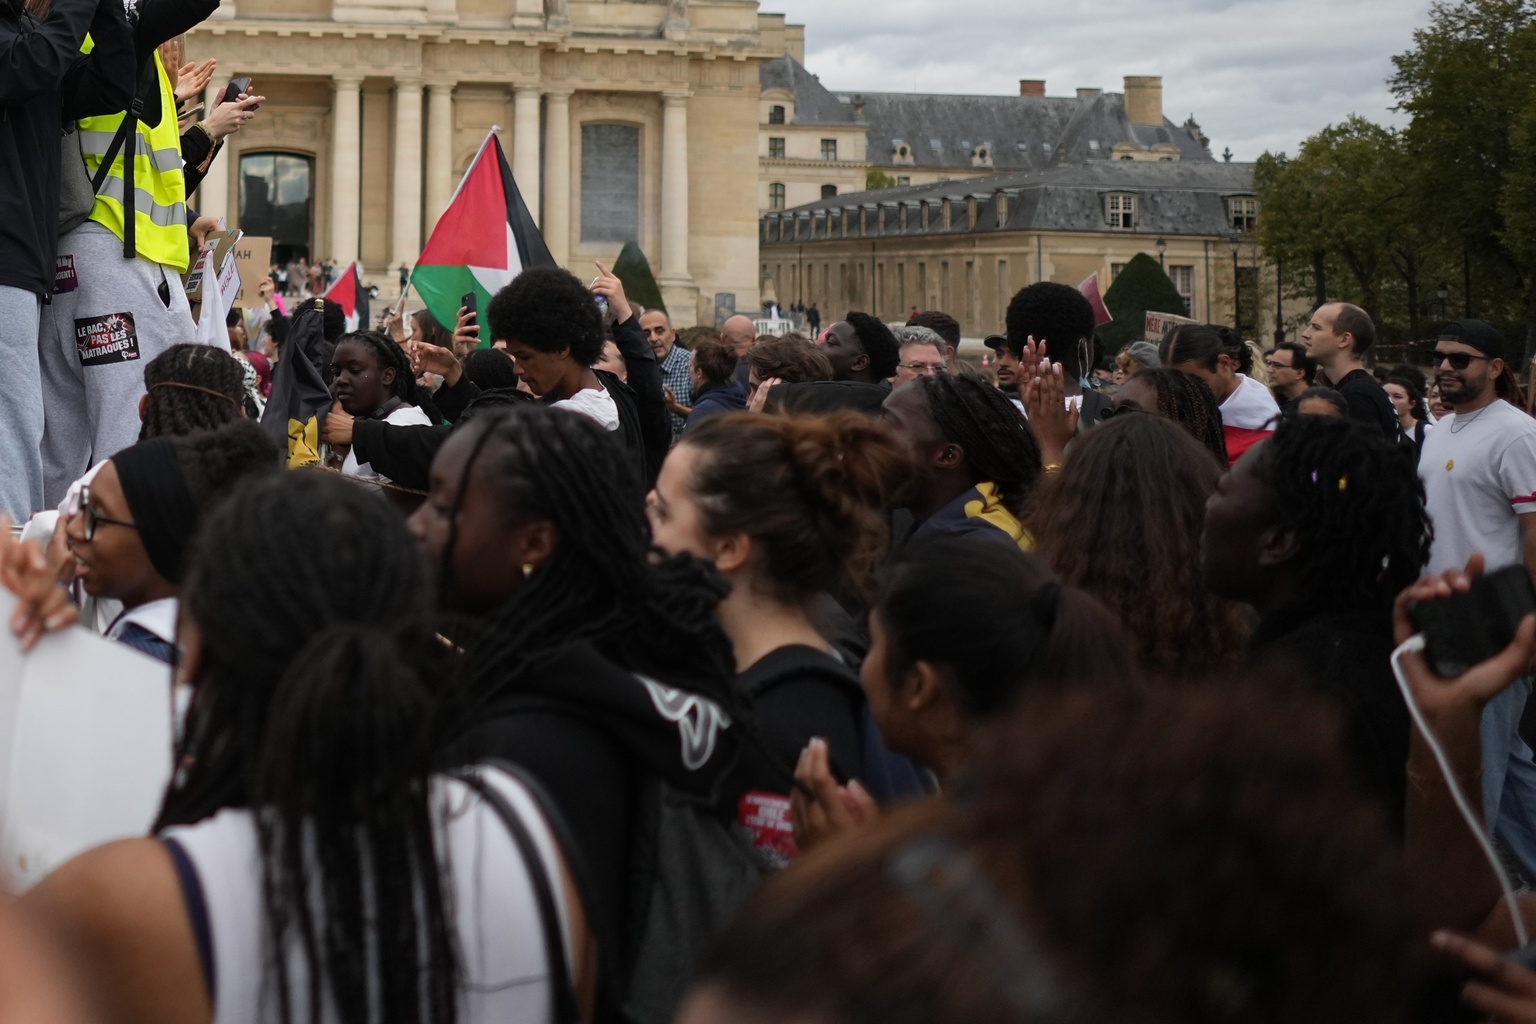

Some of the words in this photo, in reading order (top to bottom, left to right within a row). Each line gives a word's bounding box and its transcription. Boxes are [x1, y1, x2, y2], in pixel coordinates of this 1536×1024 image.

[77, 326, 87, 338] LE
[90, 333, 109, 345] PAS
[110, 329, 127, 342] LES
